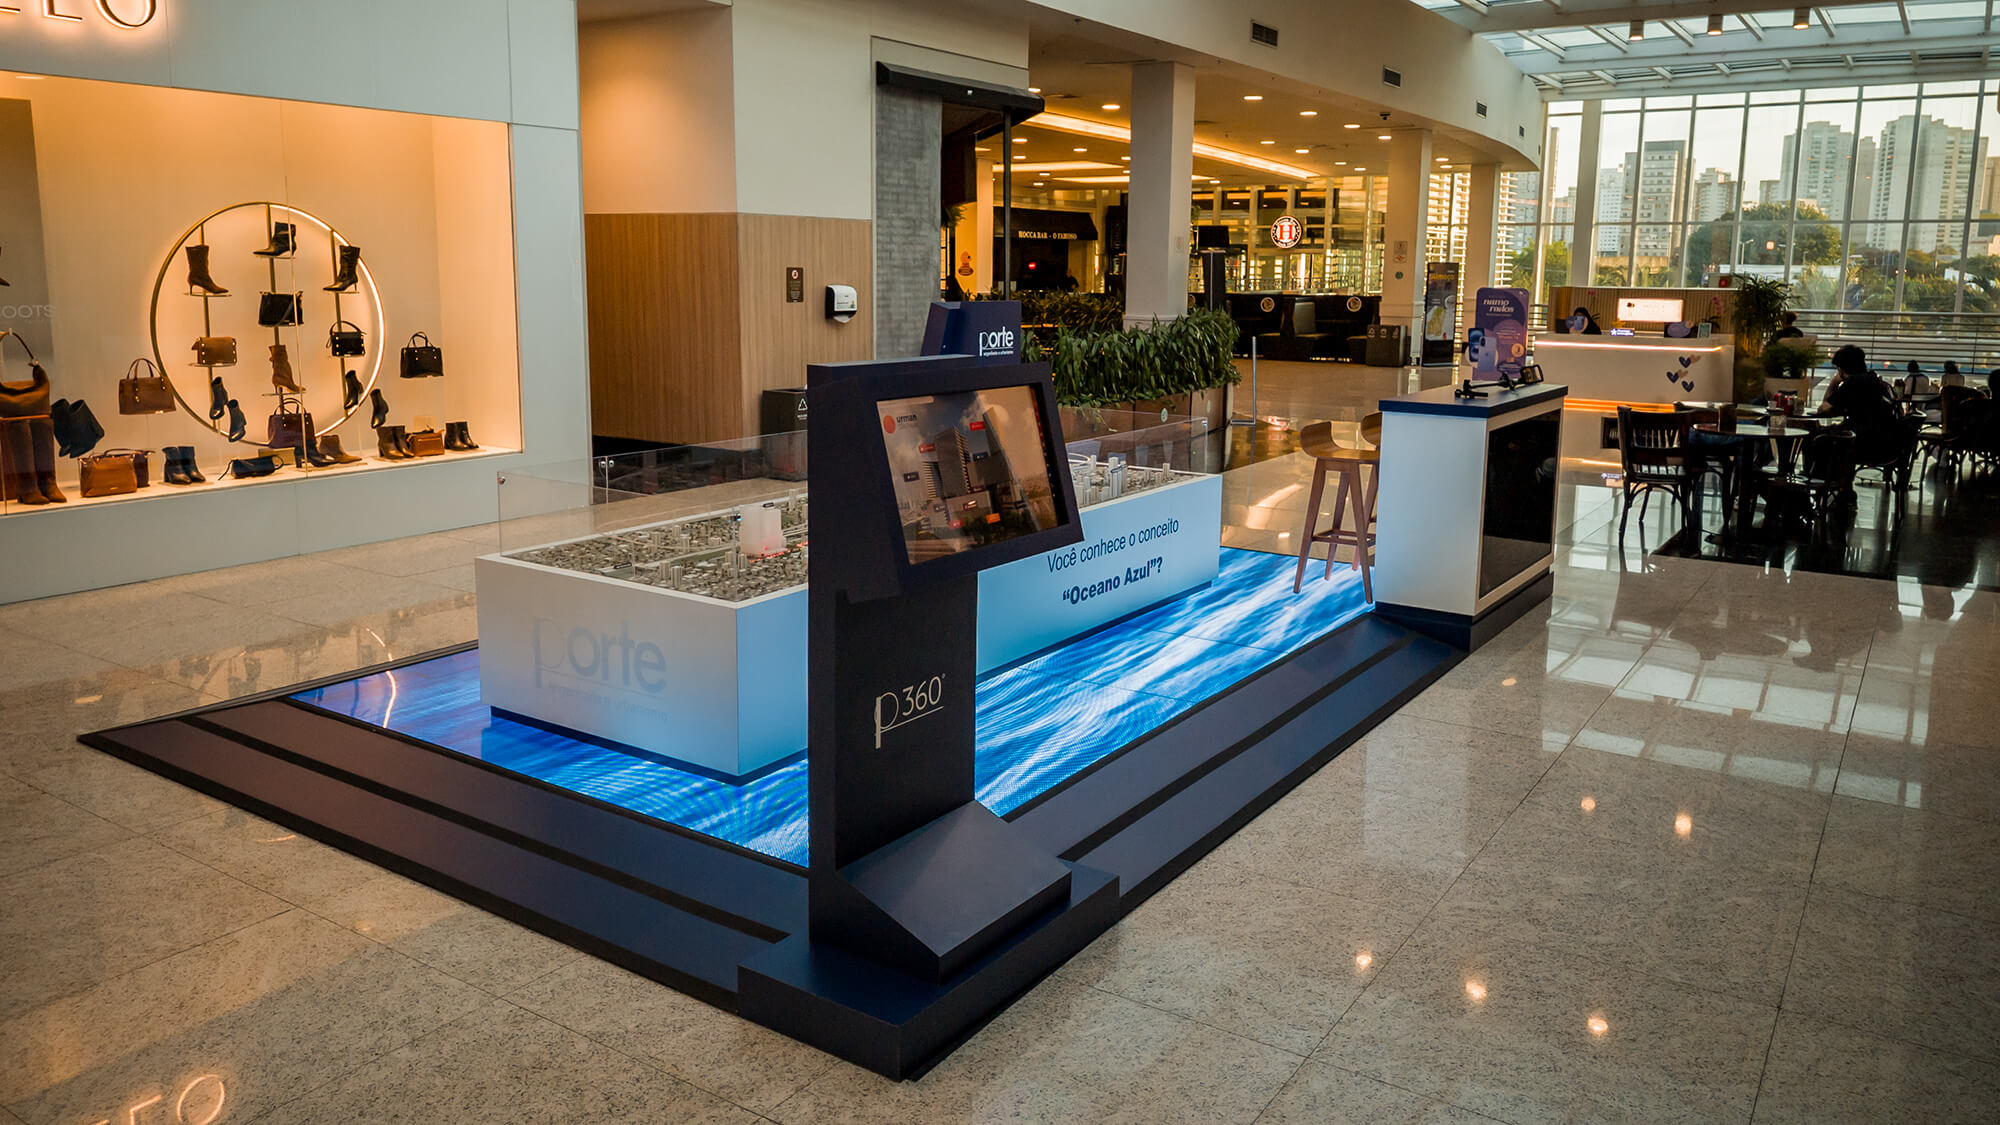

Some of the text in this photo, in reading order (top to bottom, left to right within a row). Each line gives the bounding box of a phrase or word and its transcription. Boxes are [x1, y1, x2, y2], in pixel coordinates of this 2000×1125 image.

[1279, 224, 1294, 240] H
[0, 304, 56, 318] OOTS
[979, 326, 1014, 357] porte
[1047, 517, 1179, 573] Você conhece o conceito
[1062, 575, 1121, 605] “Oceano
[534, 617, 668, 693] porte
